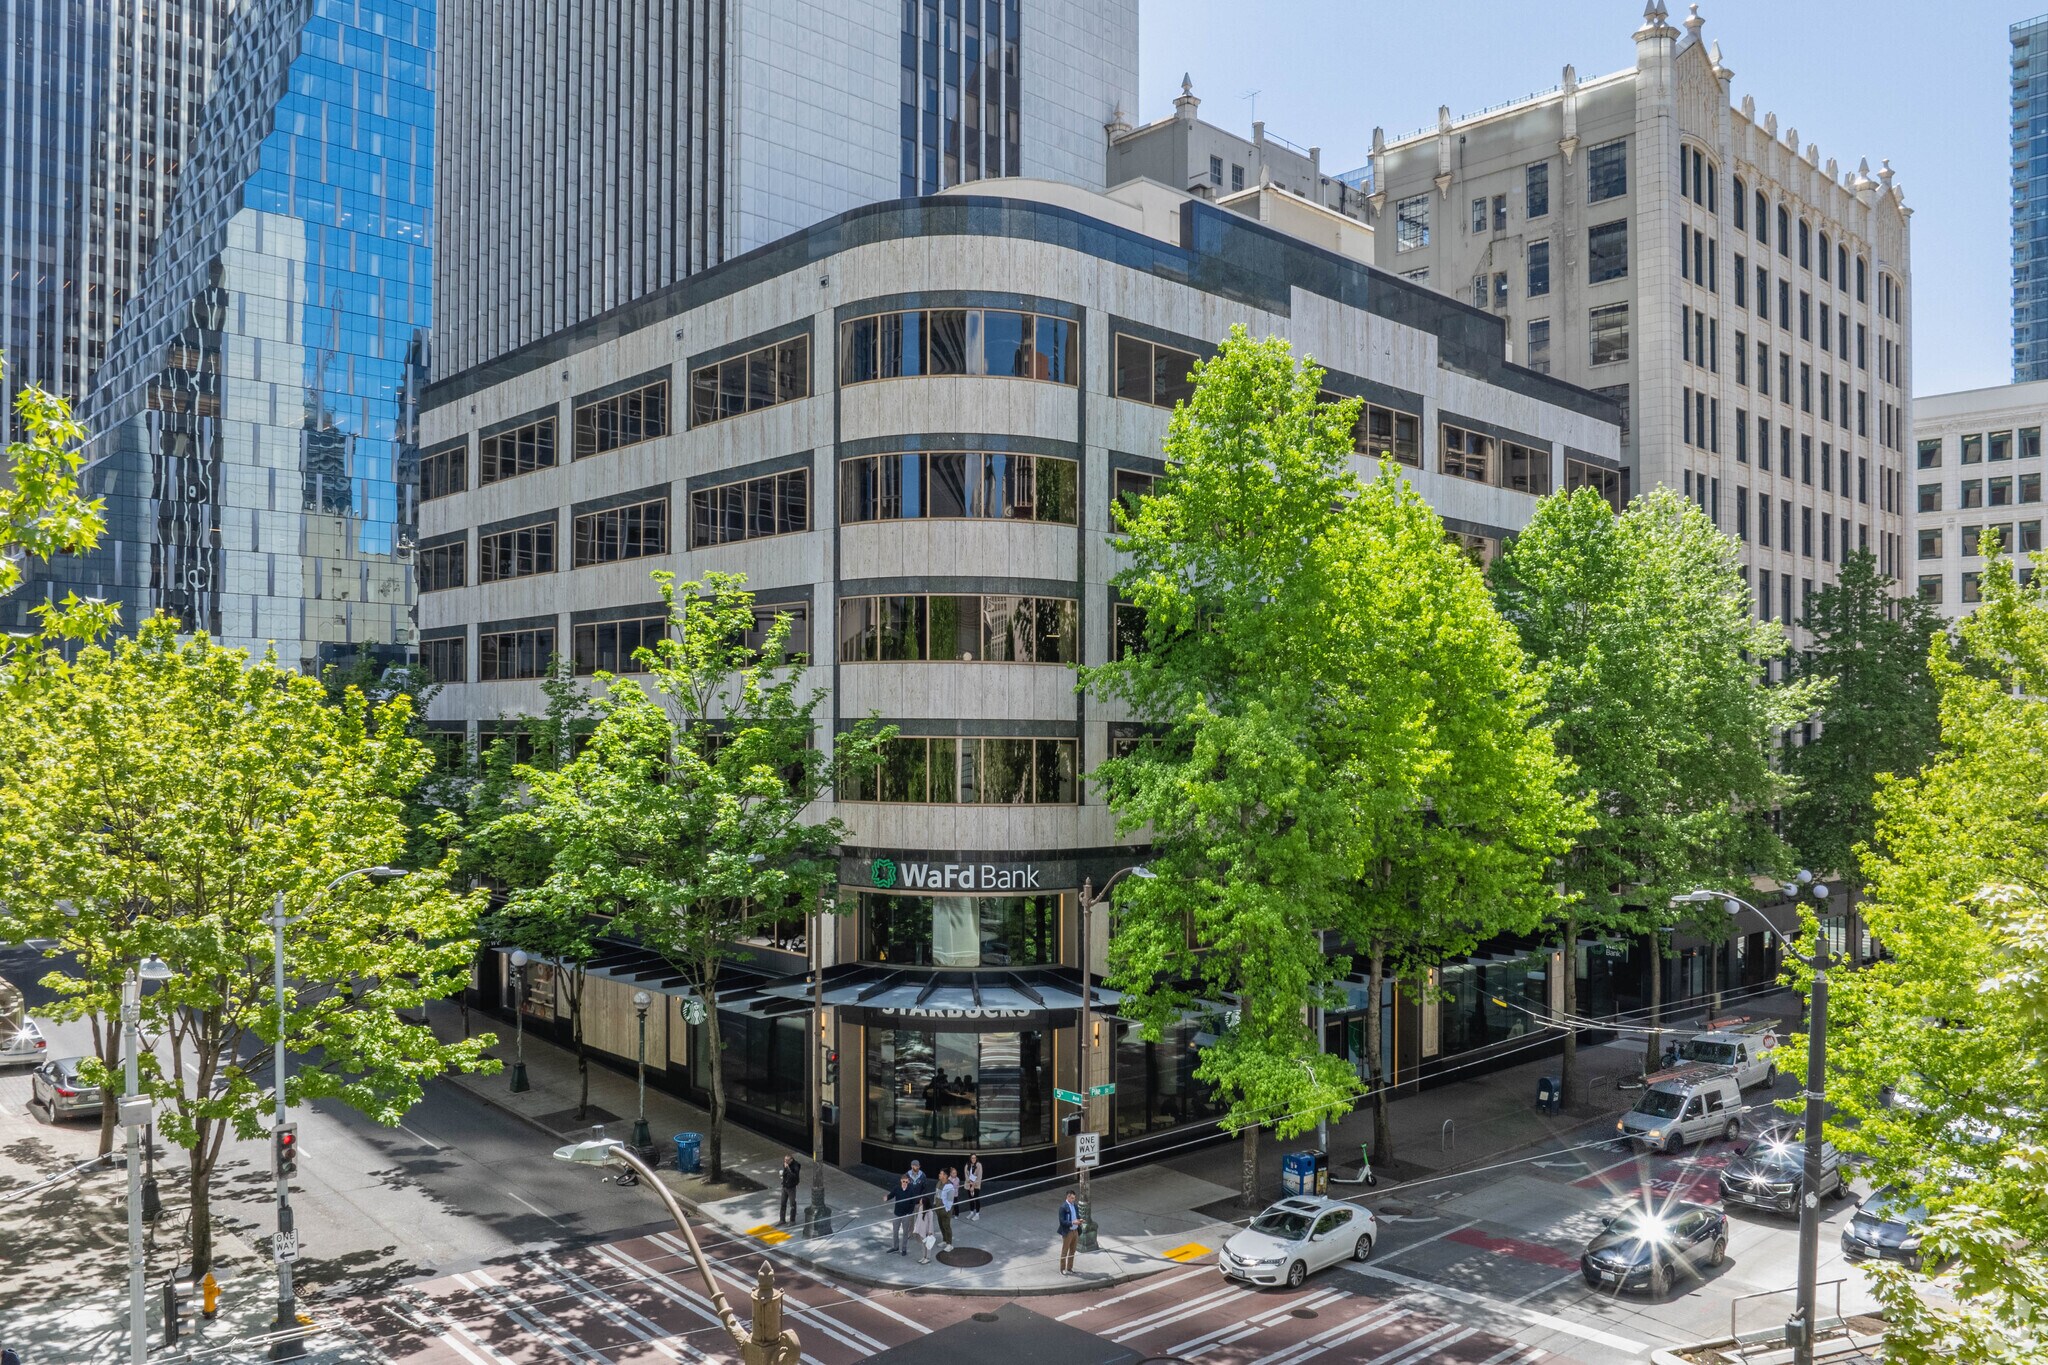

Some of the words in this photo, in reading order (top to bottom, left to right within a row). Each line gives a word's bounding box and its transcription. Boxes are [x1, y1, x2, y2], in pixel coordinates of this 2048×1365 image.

[901, 863, 975, 888] WaFd
[981, 864, 1040, 889] Bank
[1605, 949, 1621, 957] Bank
[1080, 1136, 1095, 1145] ONE
[1079, 1145, 1095, 1153] WAY
[1642, 1178, 1690, 1192] BUS
[276, 1231, 295, 1243] ONE
[276, 1240, 296, 1251] WAY
